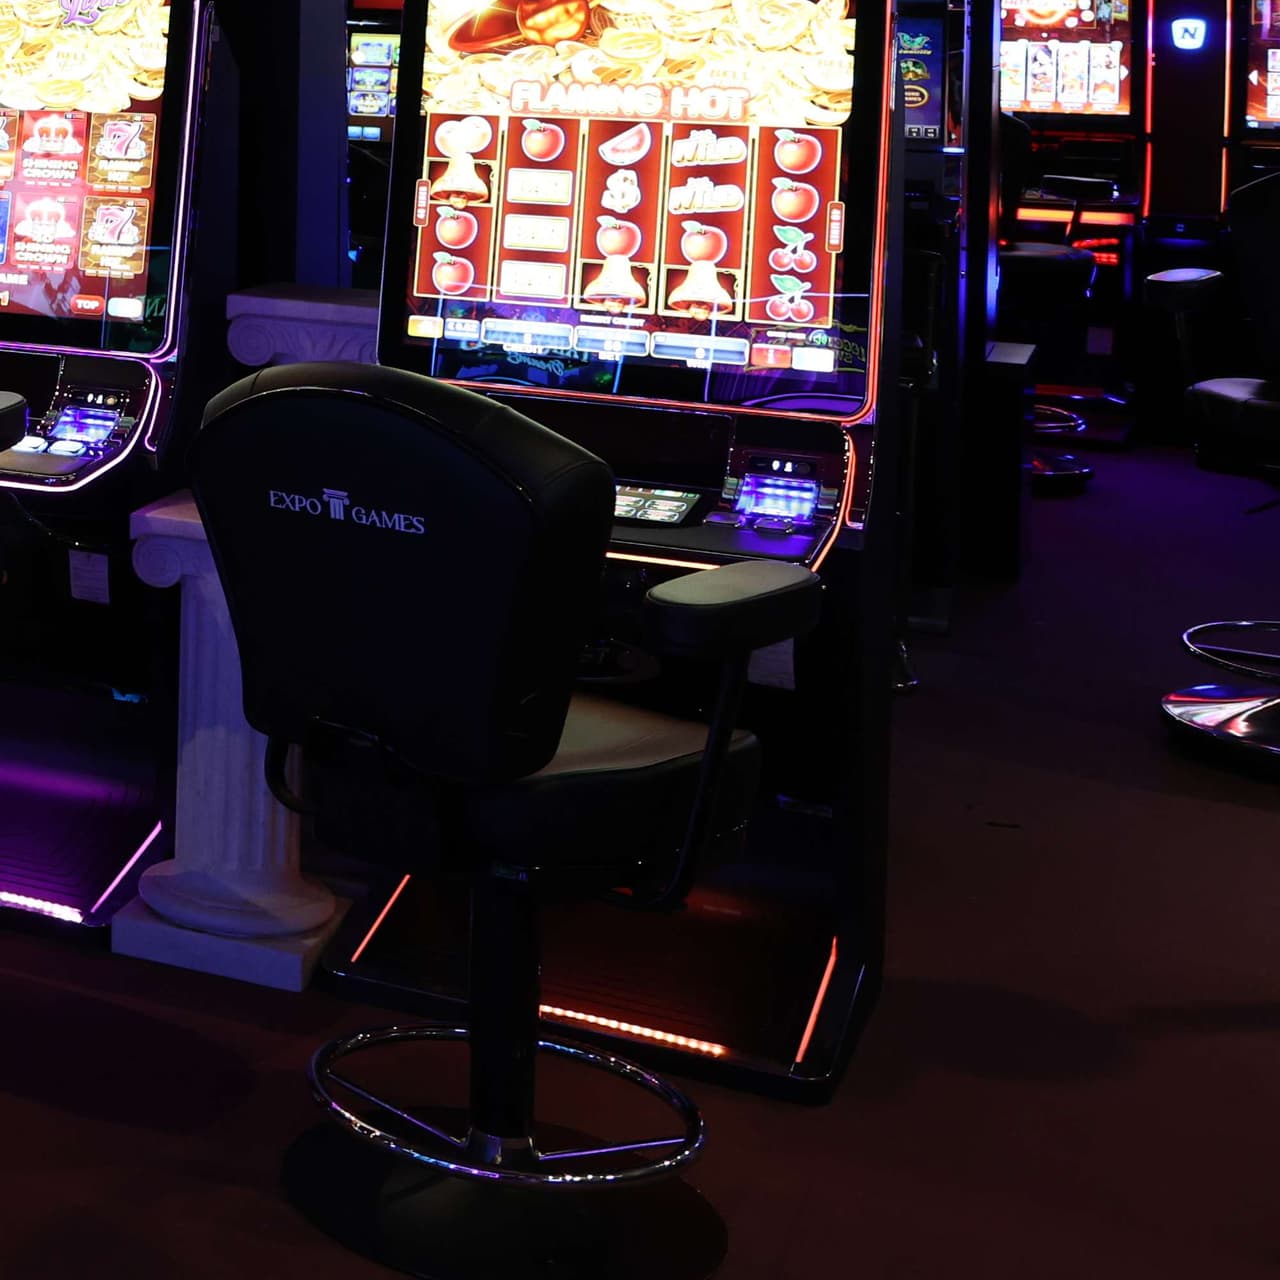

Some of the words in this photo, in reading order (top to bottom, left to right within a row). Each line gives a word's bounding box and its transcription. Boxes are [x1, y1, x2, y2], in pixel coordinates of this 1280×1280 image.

[1180, 24, 1197, 40] N
[511, 80, 662, 117] FLAMING
[671, 87, 751, 119] HOT
[76, 300, 99, 310] TOP
[269, 490, 321, 515] EXPO
[352, 507, 424, 534] GAMES
